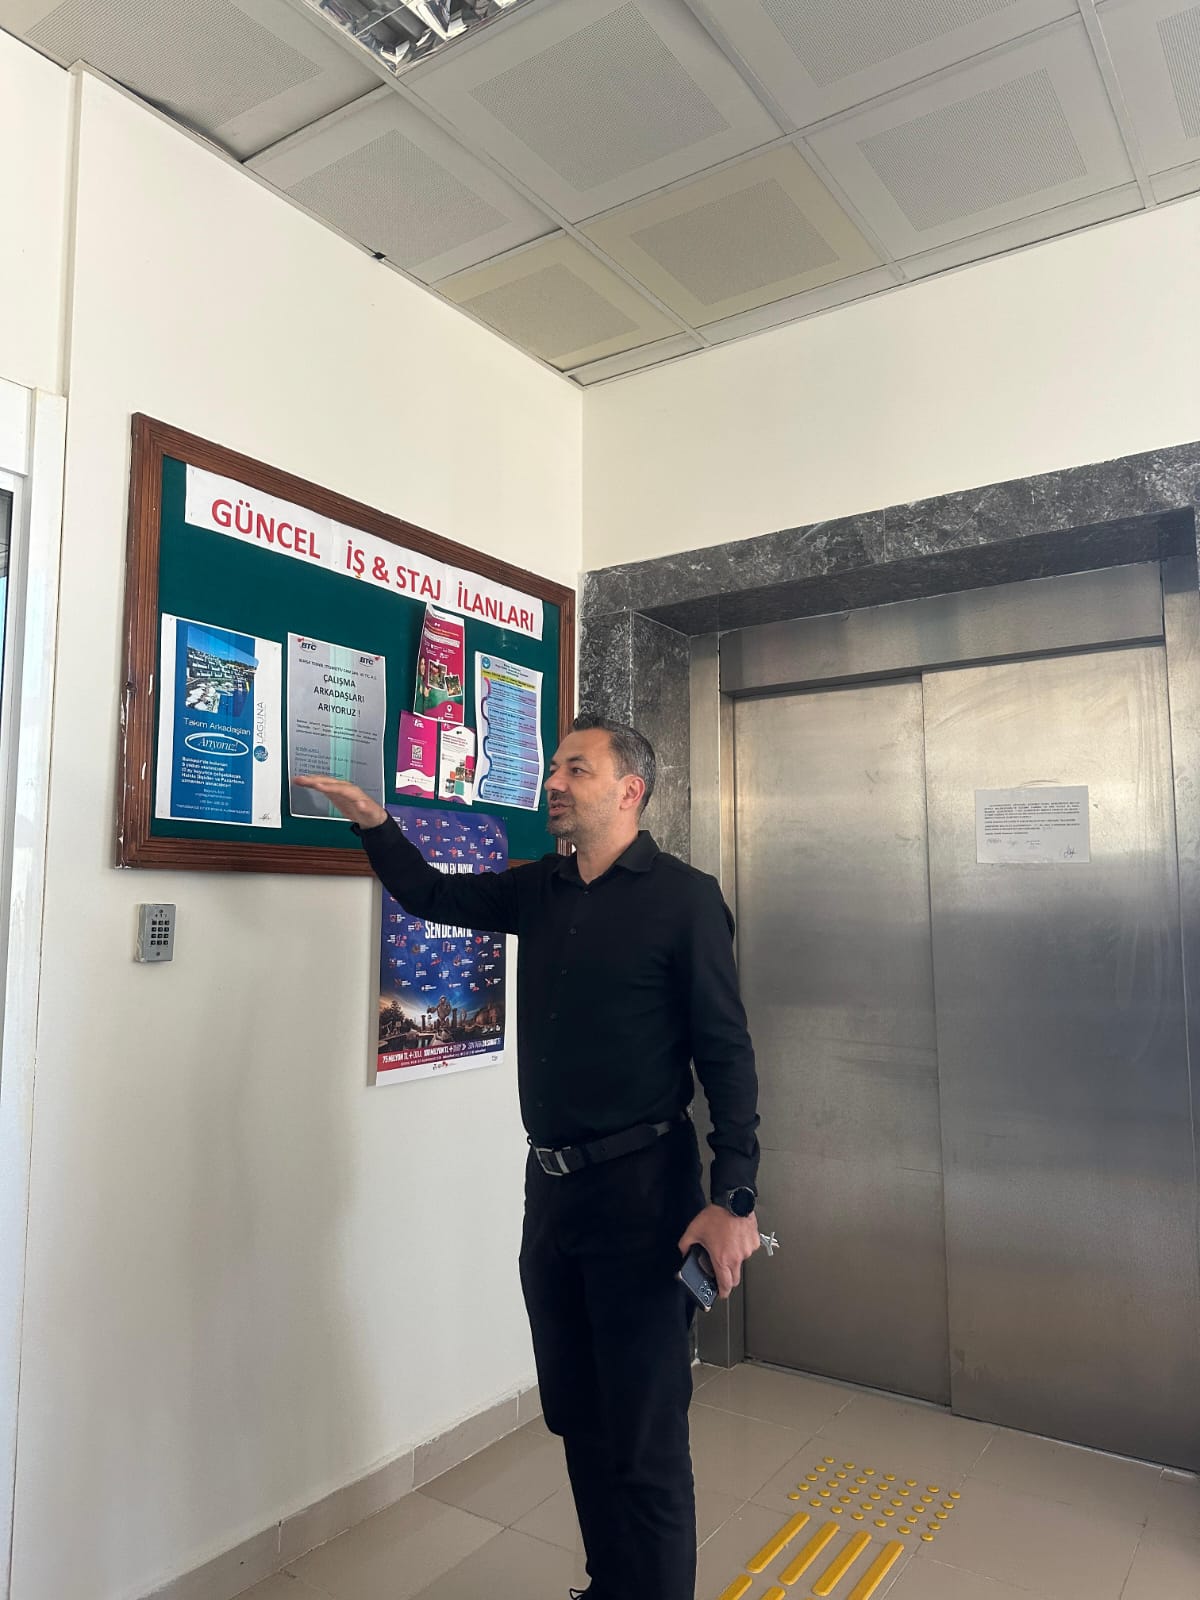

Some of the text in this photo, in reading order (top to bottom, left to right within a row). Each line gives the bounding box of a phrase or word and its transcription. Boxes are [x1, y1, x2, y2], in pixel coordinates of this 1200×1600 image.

[211, 498, 534, 633] GÜNCEL İŞ & STAJ İLANLARI
[301, 642, 317, 651] BTC
[360, 656, 374, 666] BTC
[323, 674, 356, 688] ÇALIŞMA
[313, 685, 365, 703] ARKADAŞLARI
[317, 702, 357, 717] ARIYORUZ
[184, 717, 251, 736] Takım Arkadaşları
[256, 701, 265, 745] LAGUNA
[424, 919, 441, 939] SEN
